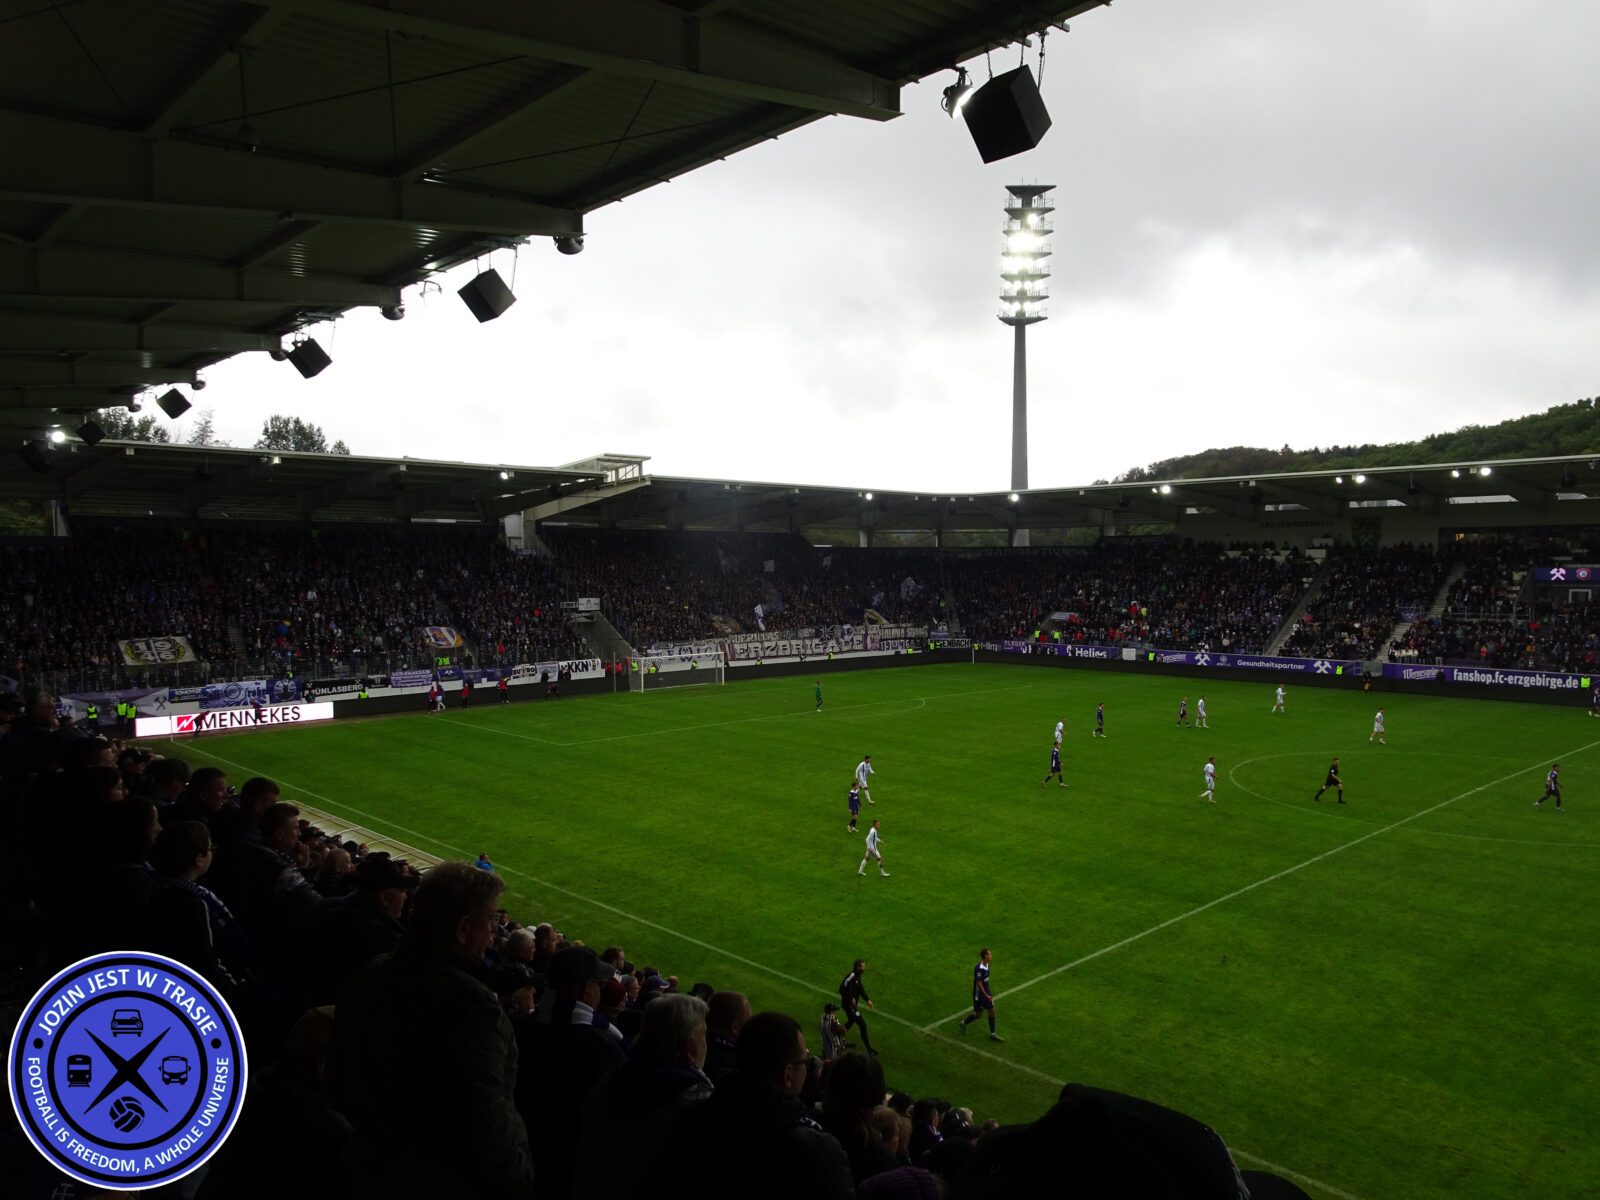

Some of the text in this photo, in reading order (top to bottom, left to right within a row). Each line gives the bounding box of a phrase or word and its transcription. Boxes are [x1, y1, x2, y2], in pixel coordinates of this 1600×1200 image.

[1075, 647, 1107, 660] Helios
[1237, 659, 1305, 671] Gesundheitspartner
[1453, 668, 1579, 693] fanshop.fc-erzgebirge.de
[202, 706, 300, 729] MENNEKES
